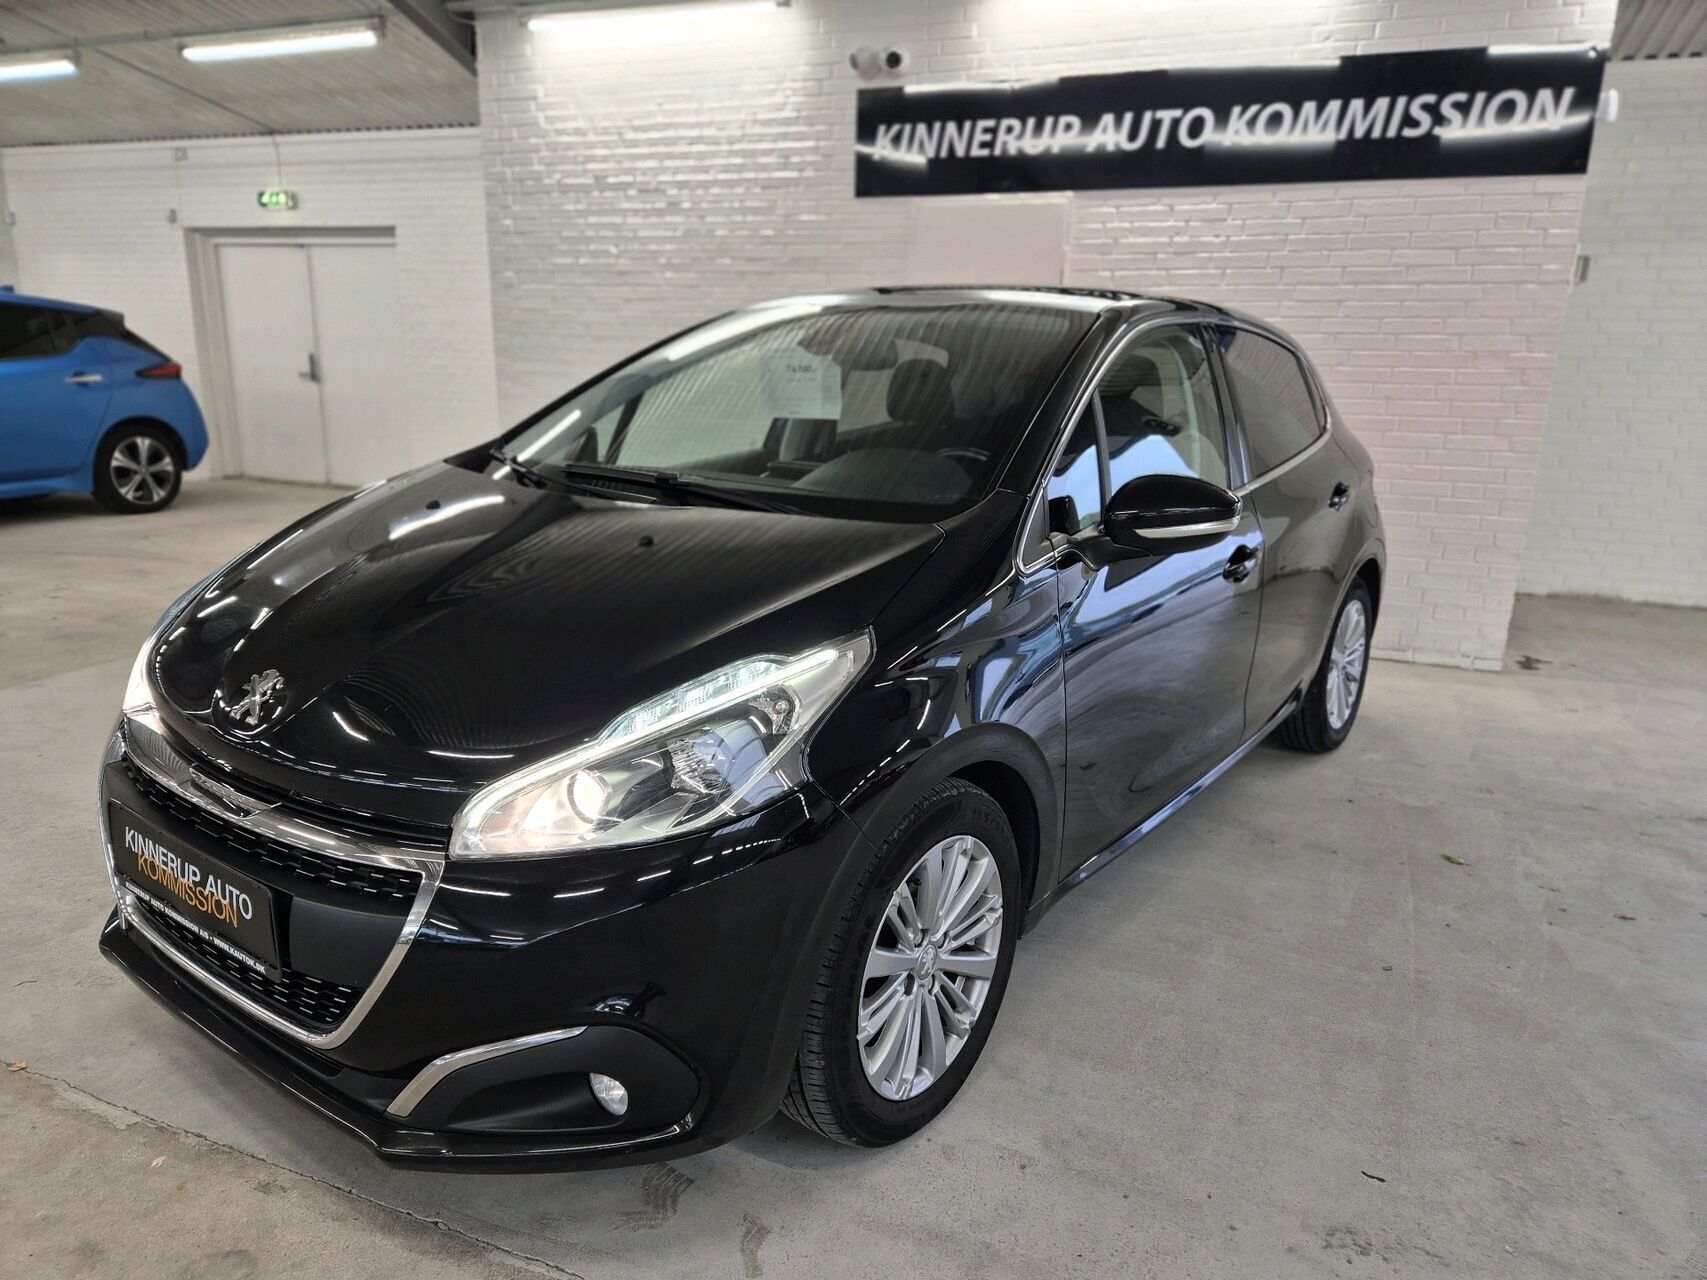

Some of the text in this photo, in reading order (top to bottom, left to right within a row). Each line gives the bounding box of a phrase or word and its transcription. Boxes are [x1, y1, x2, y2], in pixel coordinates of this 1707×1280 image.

[873, 87, 1576, 160] KINNERUP AUTO KOMMISSION
[125, 826, 253, 920] KINNERUP AUTO
[125, 881, 150, 901] KINNERUP
[151, 898, 164, 911] AUTO
[165, 906, 199, 934] KOMMISSION
[138, 854, 238, 928] KOMMISSION
